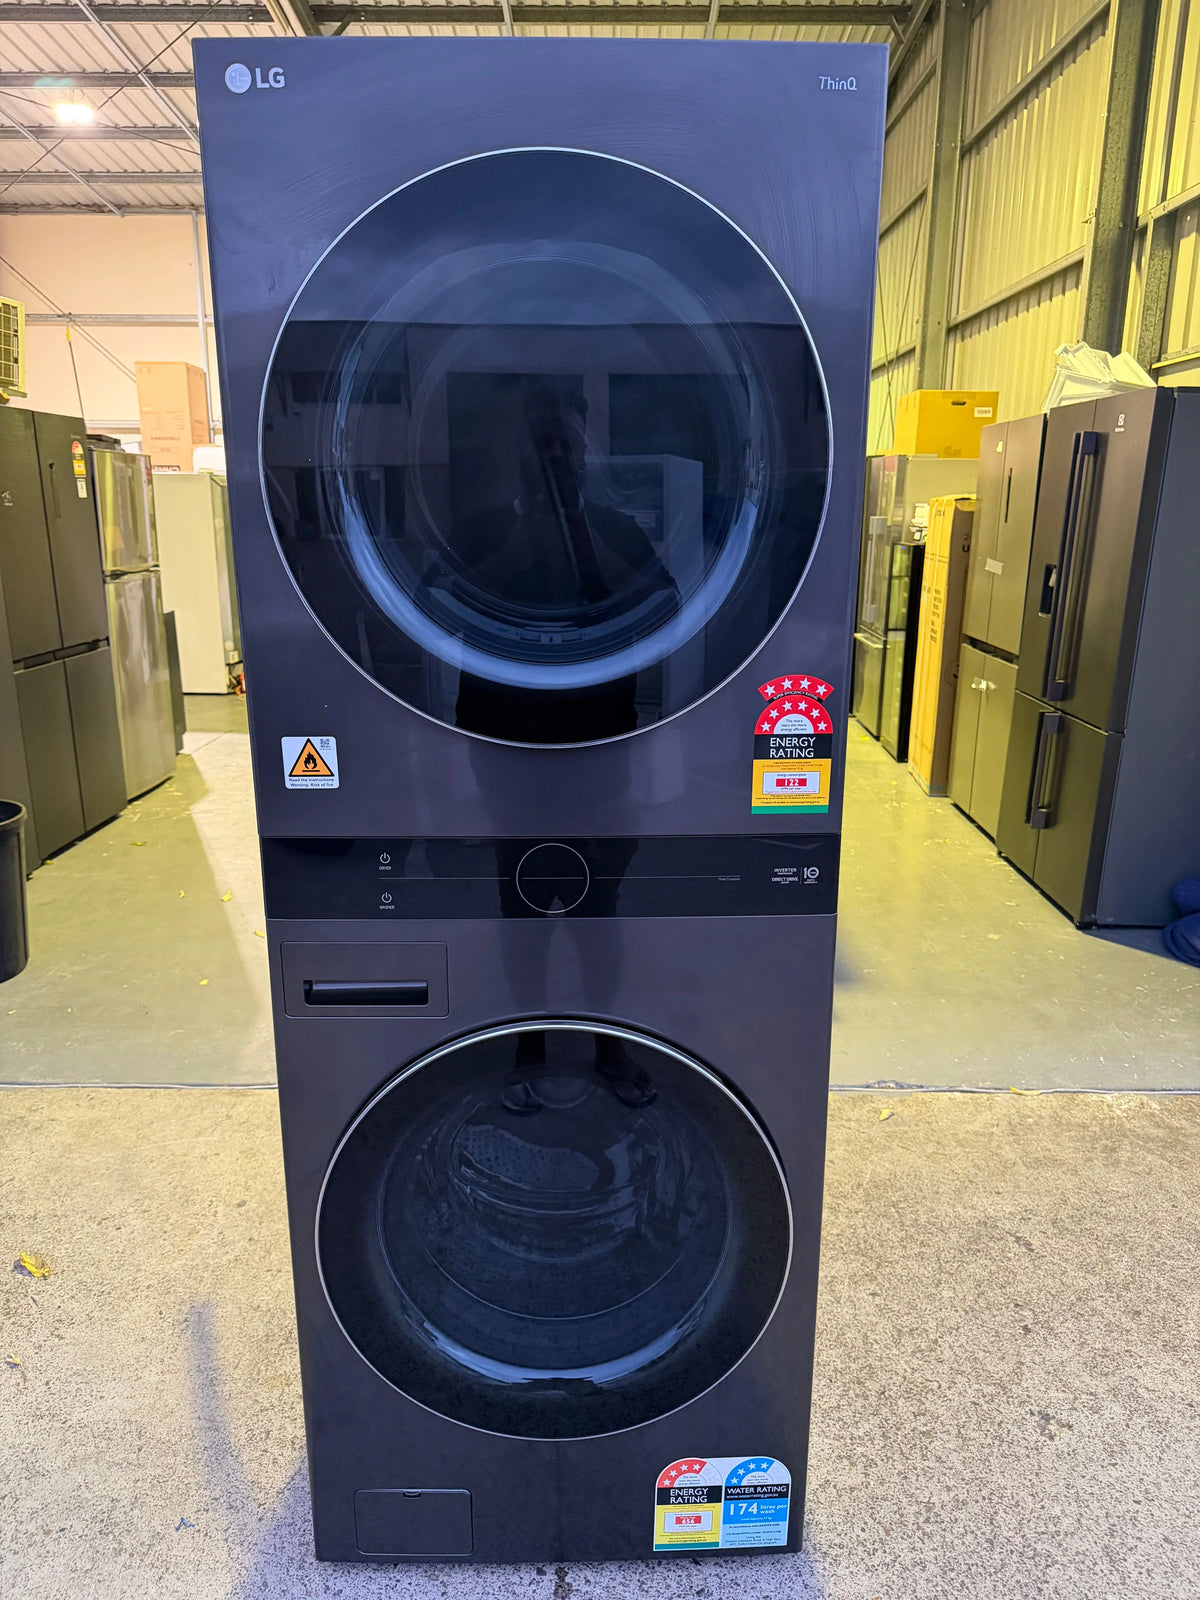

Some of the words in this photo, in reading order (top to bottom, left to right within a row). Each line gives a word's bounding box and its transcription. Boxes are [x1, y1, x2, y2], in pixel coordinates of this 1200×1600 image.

[255, 67, 285, 88] LG
[818, 76, 858, 90] ThinQ
[770, 737, 816, 746] ENERGY
[770, 748, 814, 758] RATING
[670, 1488, 709, 1496] ENERGY
[670, 1496, 708, 1504] RATING
[730, 1502, 758, 1516] 174
